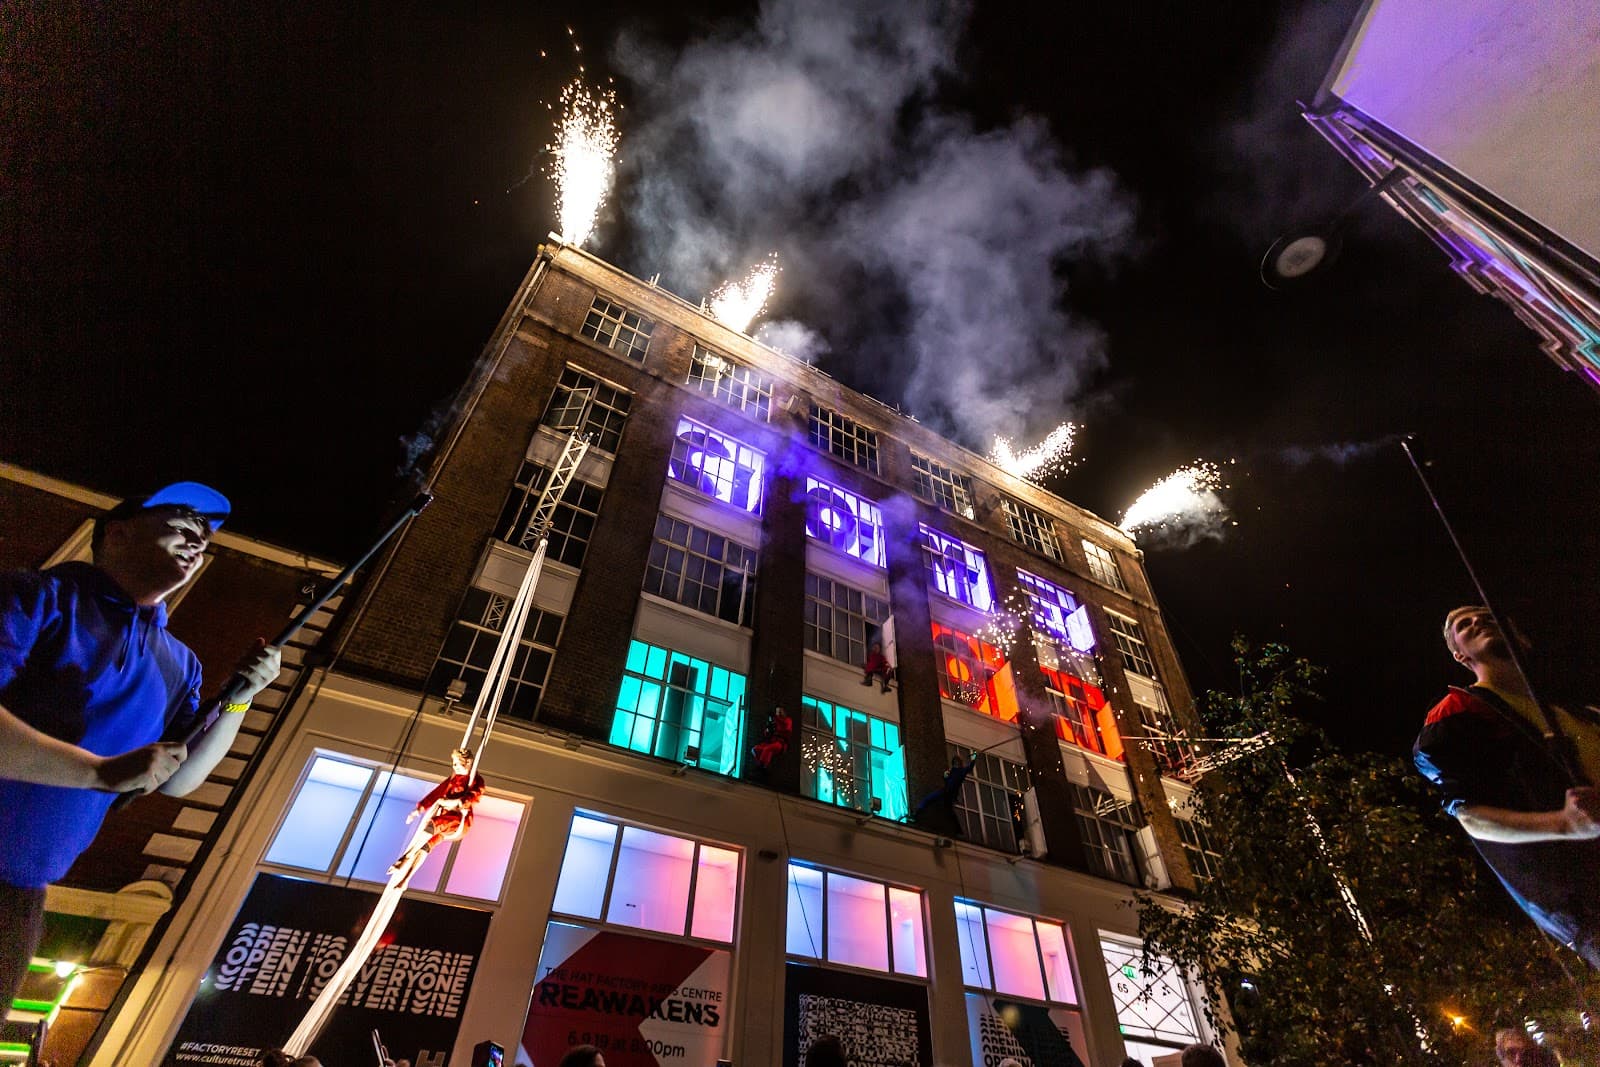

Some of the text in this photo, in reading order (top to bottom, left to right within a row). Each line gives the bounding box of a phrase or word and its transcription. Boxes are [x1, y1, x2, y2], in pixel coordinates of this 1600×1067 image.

[545, 966, 722, 1002] THE HAT FACTORY ARTS CENTRE
[1117, 982, 1129, 994] 65
[539, 981, 720, 1028] REAWAKENS
[180, 1042, 261, 1058] #FACTORYRESET
